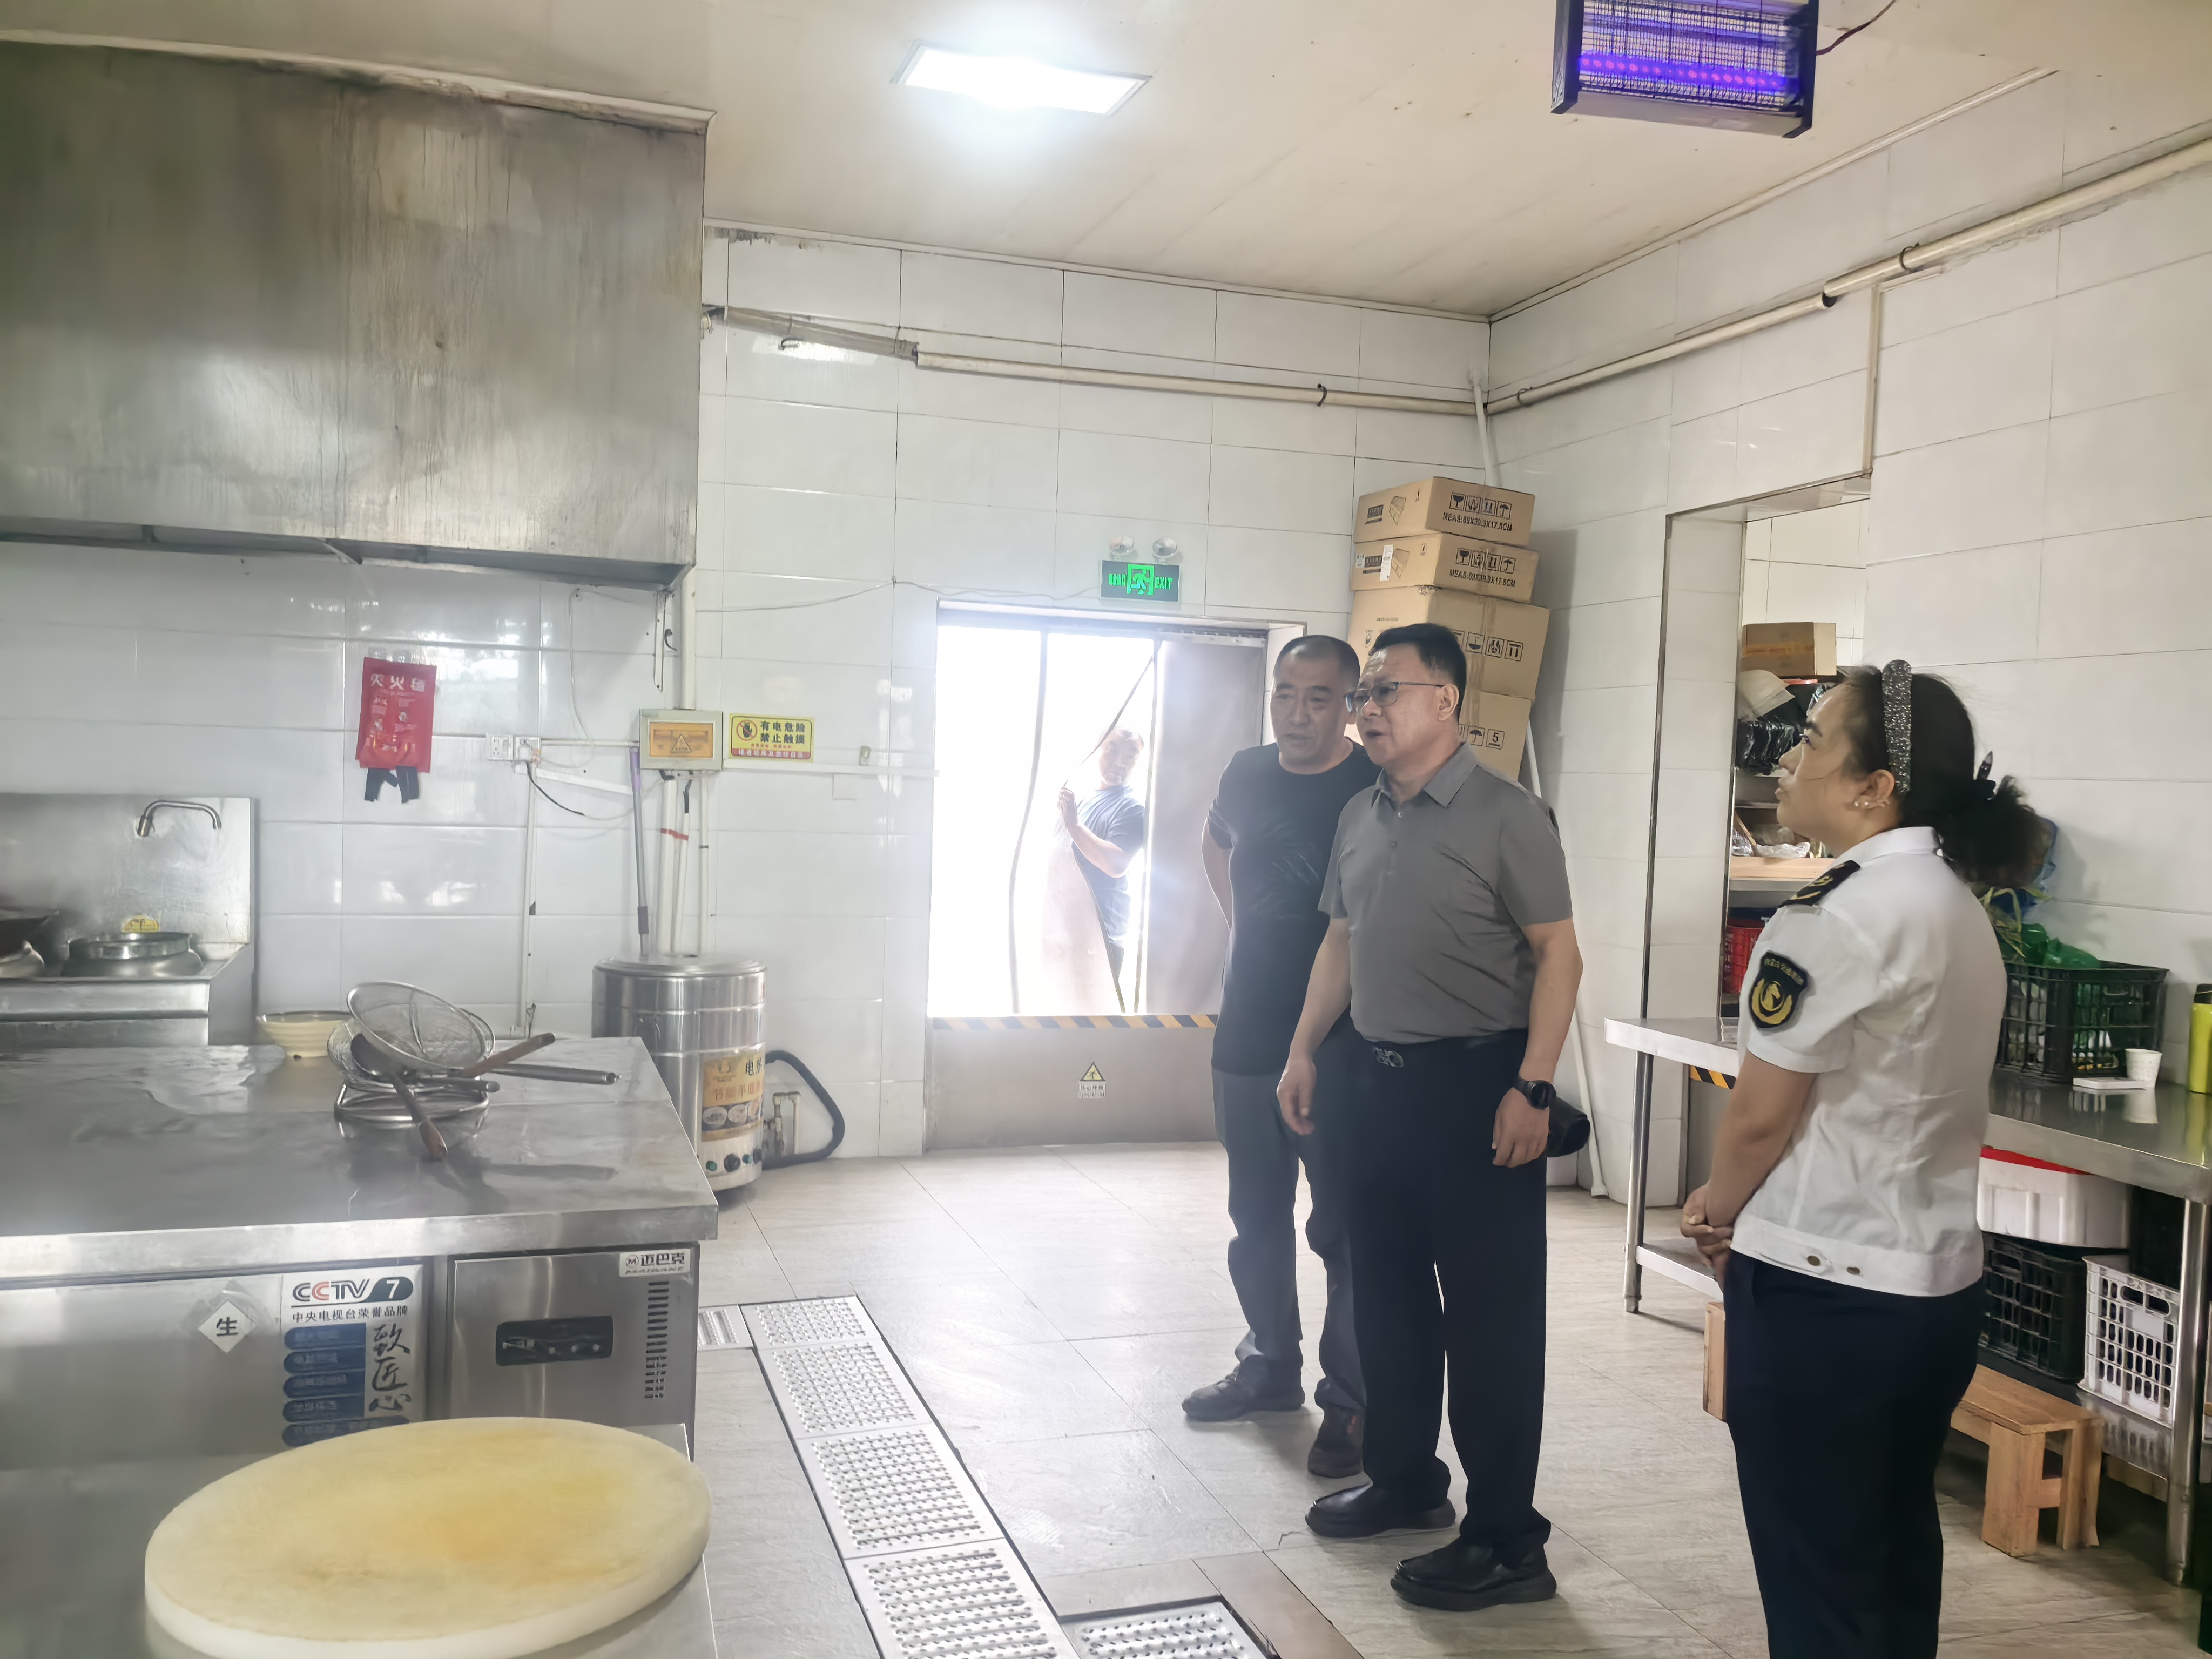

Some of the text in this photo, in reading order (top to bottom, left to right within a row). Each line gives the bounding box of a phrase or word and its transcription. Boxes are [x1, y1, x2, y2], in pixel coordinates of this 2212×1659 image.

[1155, 577, 1173, 589] EXIT
[1492, 731, 1500, 743] 5
[640, 1252, 685, 1266] 迈巴克
[292, 1278, 400, 1302] CCTV 7
[292, 1305, 408, 1324] 中央电视台荣誉品牌
[216, 1317, 238, 1337] 生
